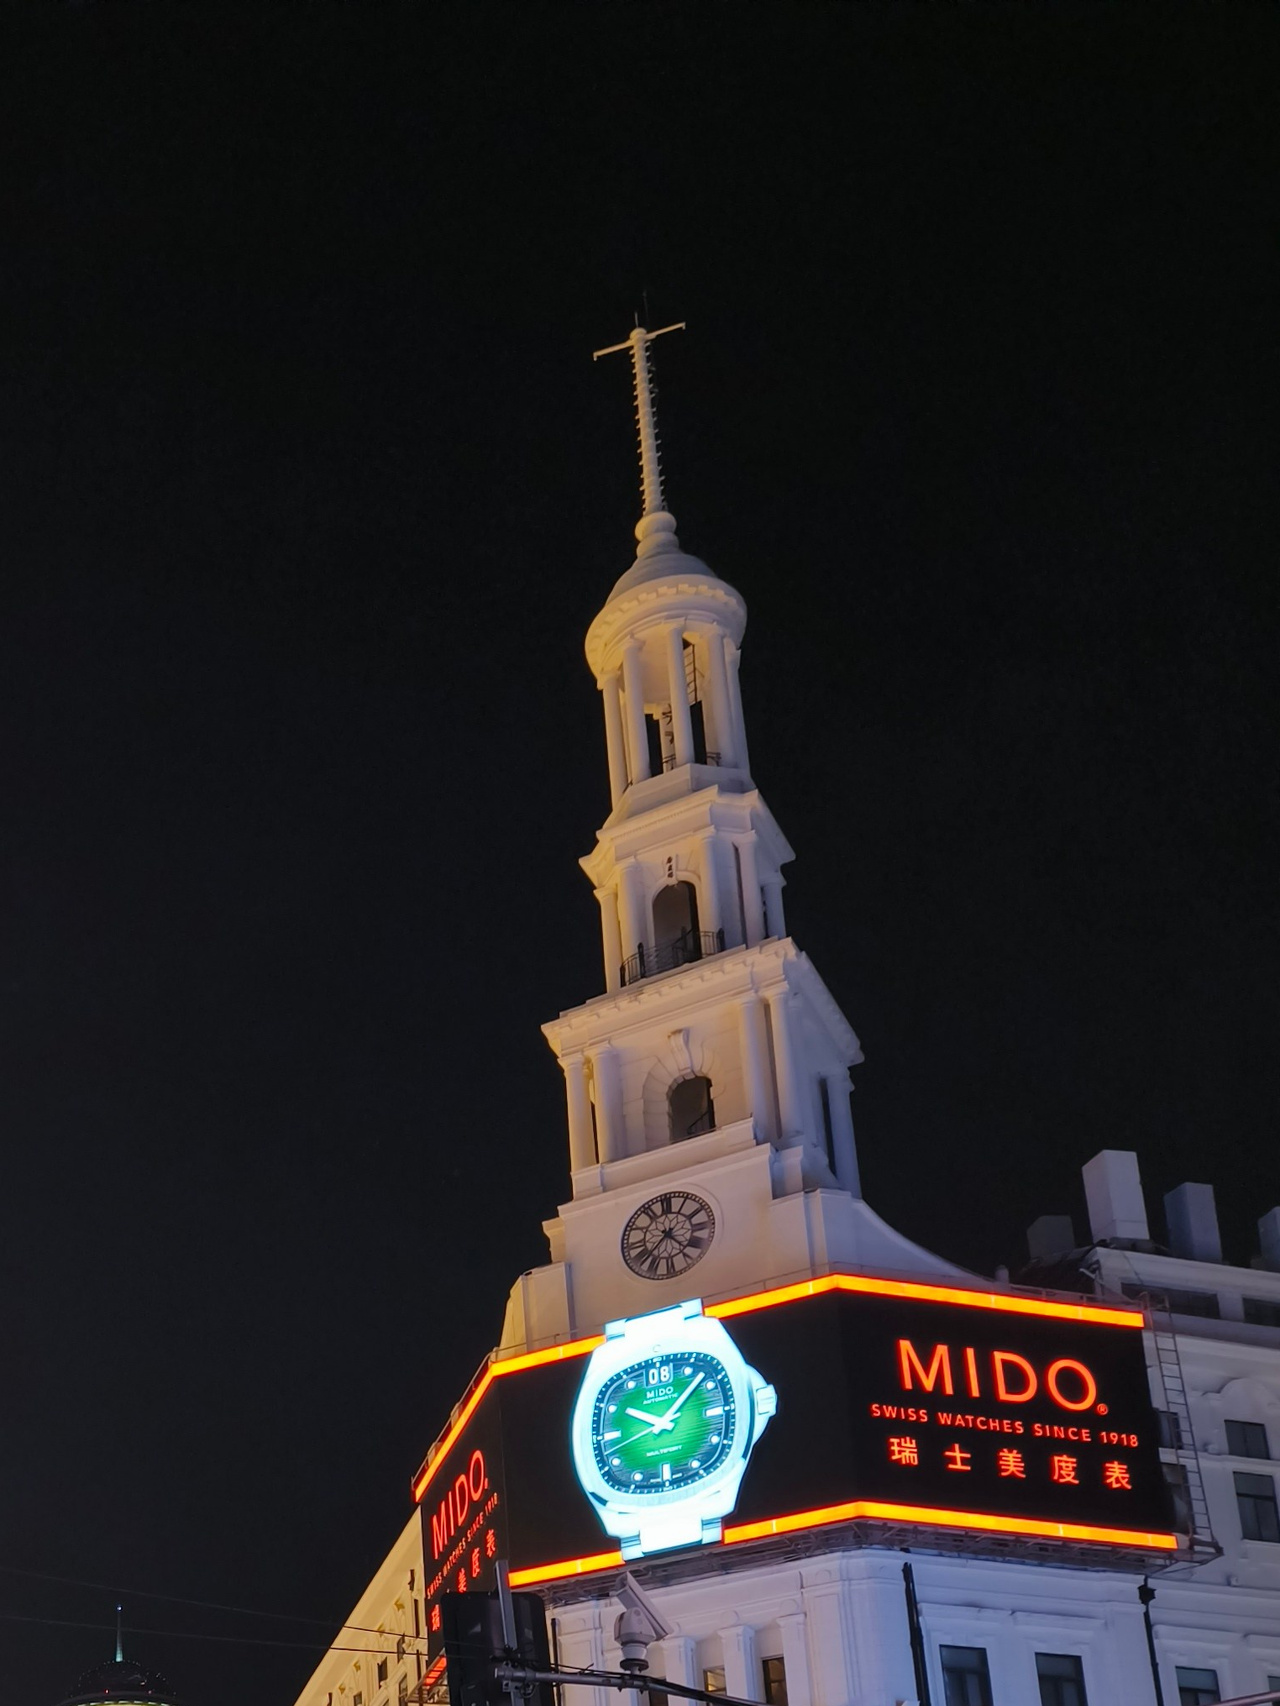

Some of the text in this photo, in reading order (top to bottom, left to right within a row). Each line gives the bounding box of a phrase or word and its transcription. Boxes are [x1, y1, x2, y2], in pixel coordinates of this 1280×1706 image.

[646, 1386, 674, 1399] MIDO
[871, 1403, 1139, 1448] SWISS WATCHES SINCE 1918
[889, 1436, 1132, 1490] 瑞士美度表
